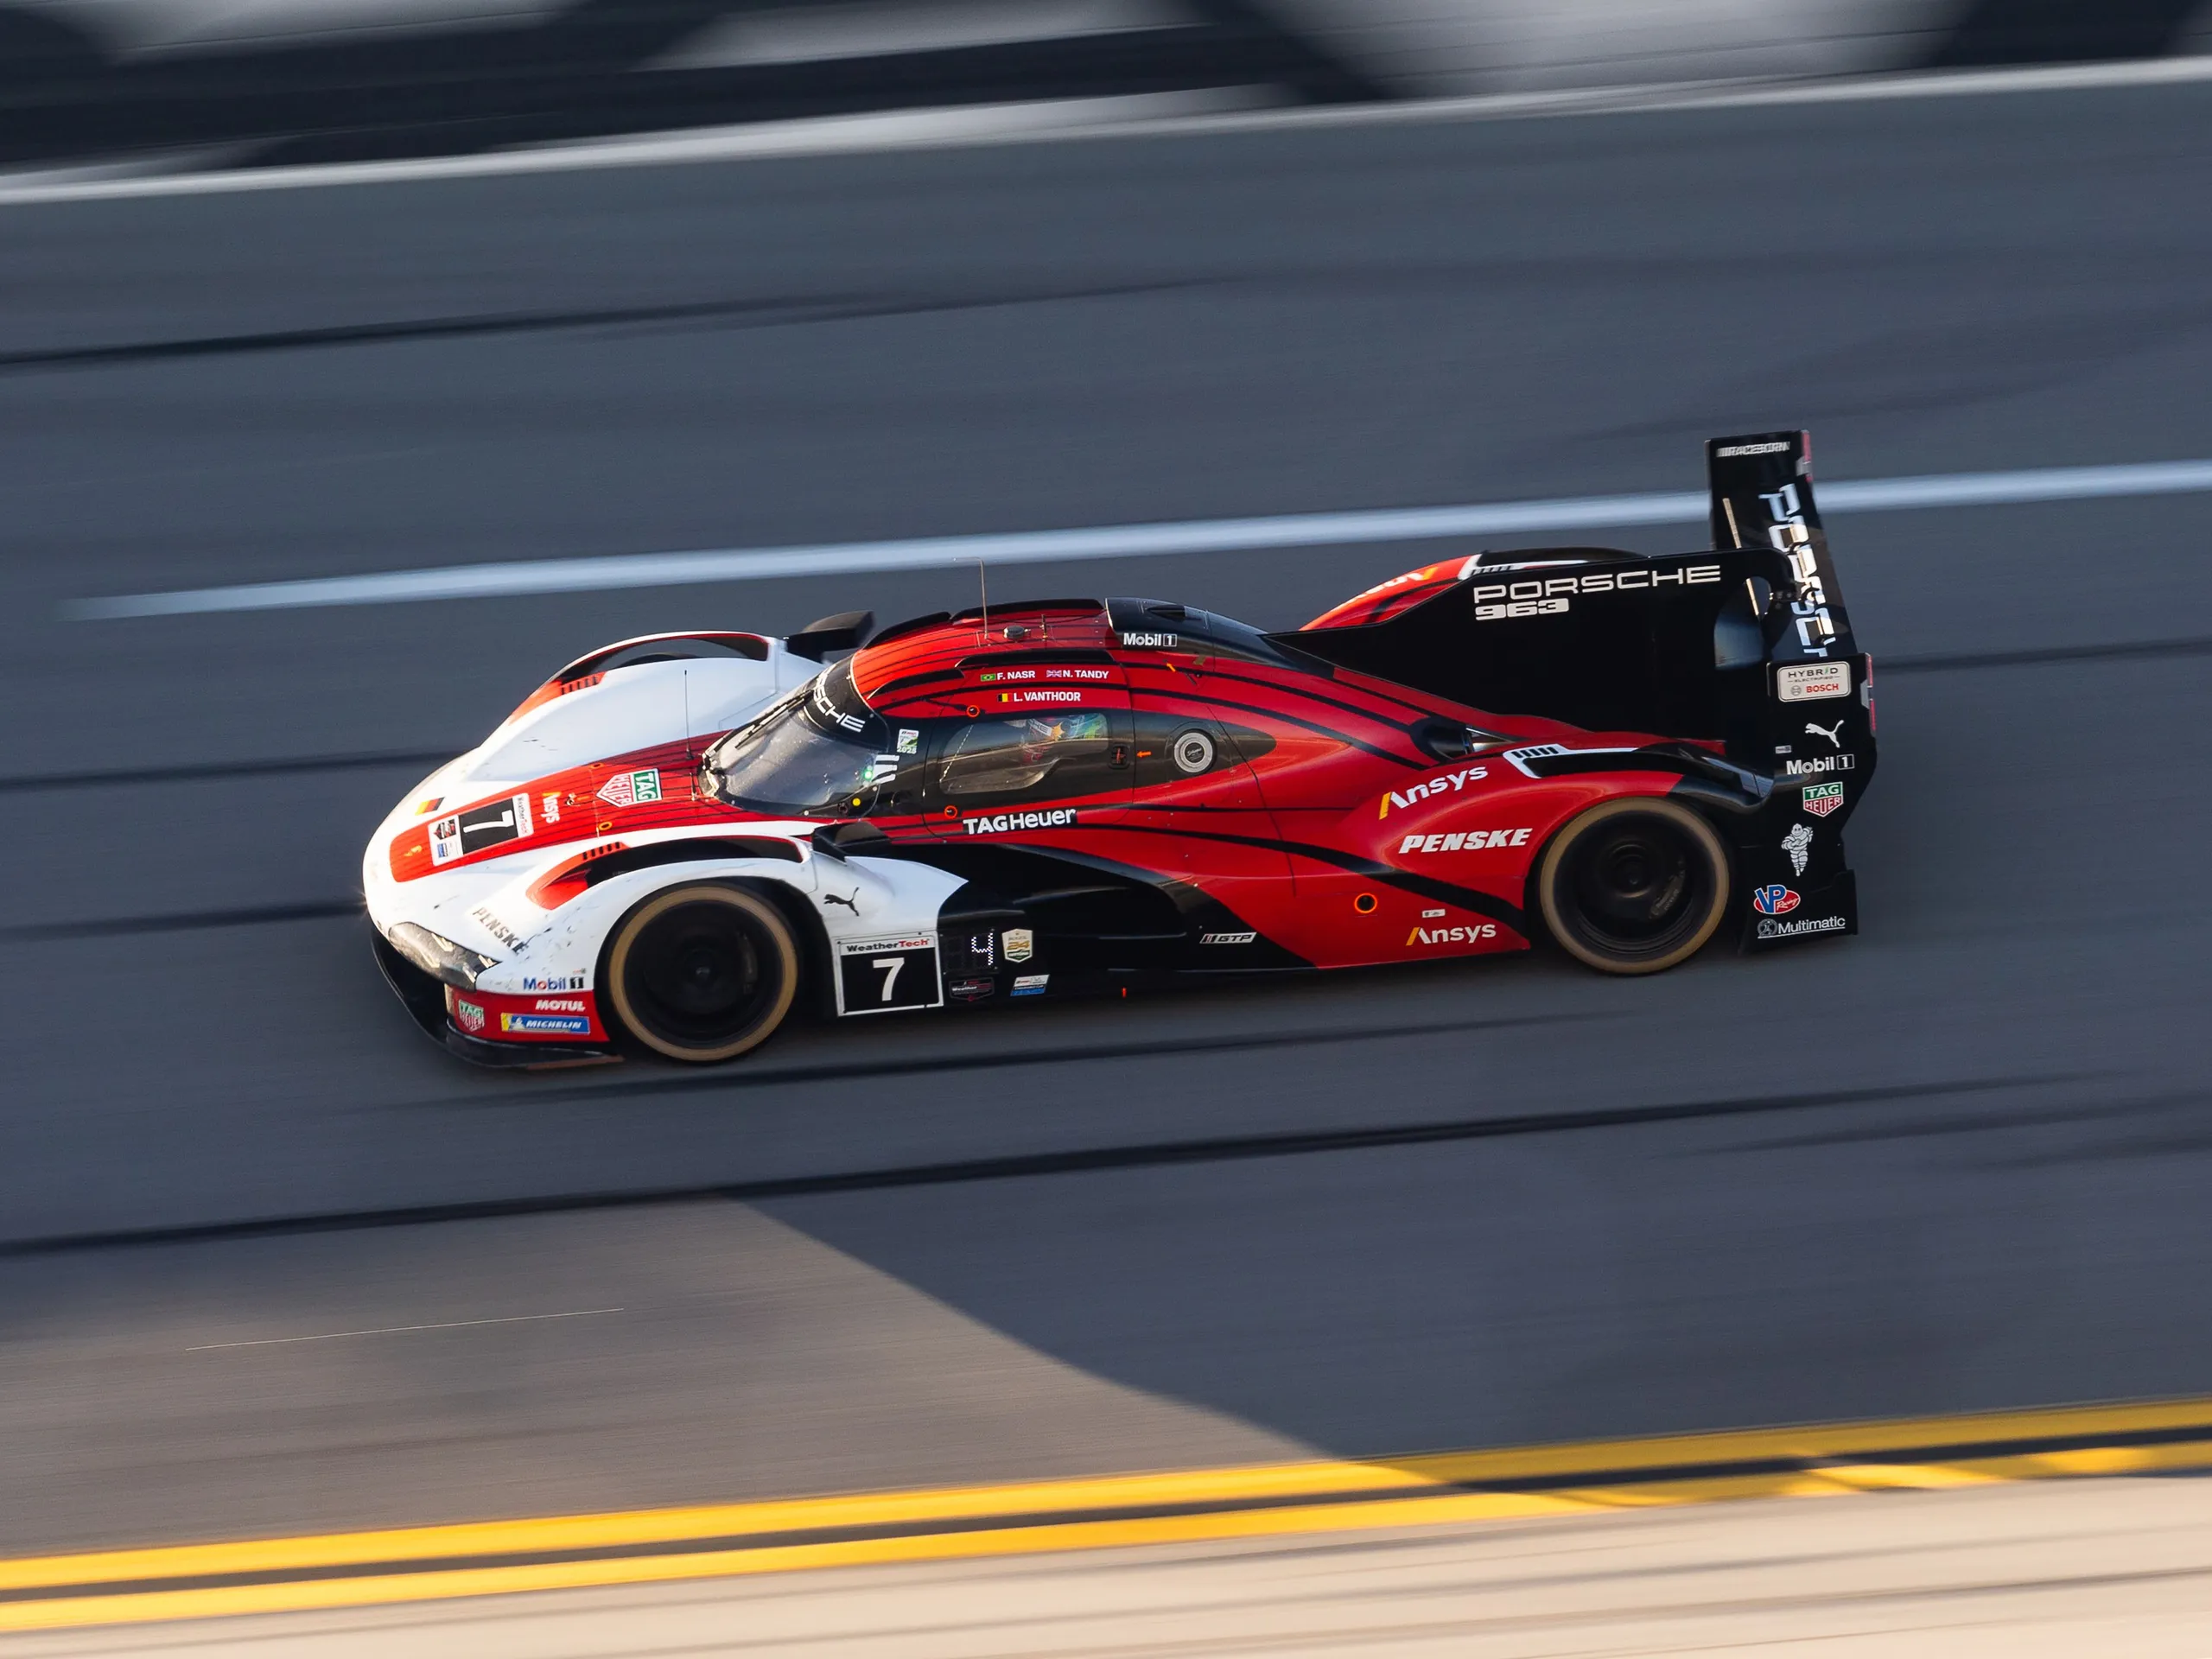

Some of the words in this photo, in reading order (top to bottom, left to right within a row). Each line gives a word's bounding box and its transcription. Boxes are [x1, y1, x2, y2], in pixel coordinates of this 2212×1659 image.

[1473, 565, 1721, 604] PORSCHE
[1475, 598, 1570, 621] 963
[1123, 632, 1162, 647] Mobil
[1007, 671, 1036, 680] NASR
[1063, 670, 1072, 678] N.
[1074, 670, 1109, 680] TANDY
[1788, 667, 1839, 678] HYBRID
[1014, 692, 1022, 702] L.
[1024, 691, 1081, 702] VANTHOOR
[1806, 683, 1840, 693] BOSCH
[1786, 757, 1834, 775] Mobil
[634, 772, 655, 801] TAG
[1378, 766, 1489, 820] Ansys
[1807, 784, 1840, 798] TAG
[1804, 796, 1842, 815] HEUER
[463, 810, 515, 833] 7
[1398, 828, 1534, 855] PENSKE
[1754, 884, 1788, 914] VP
[1778, 916, 1846, 934] Multimatic
[1406, 924, 1497, 946] Ansys
[847, 938, 930, 952] WeatherTech
[971, 932, 993, 965] 4
[1007, 940, 1030, 950] 24
[523, 977, 566, 990] Mobil
[571, 977, 583, 989] 1
[873, 957, 905, 1001] 7
[535, 1000, 587, 1012] MOTUL
[525, 1020, 582, 1030] MICHELIN
